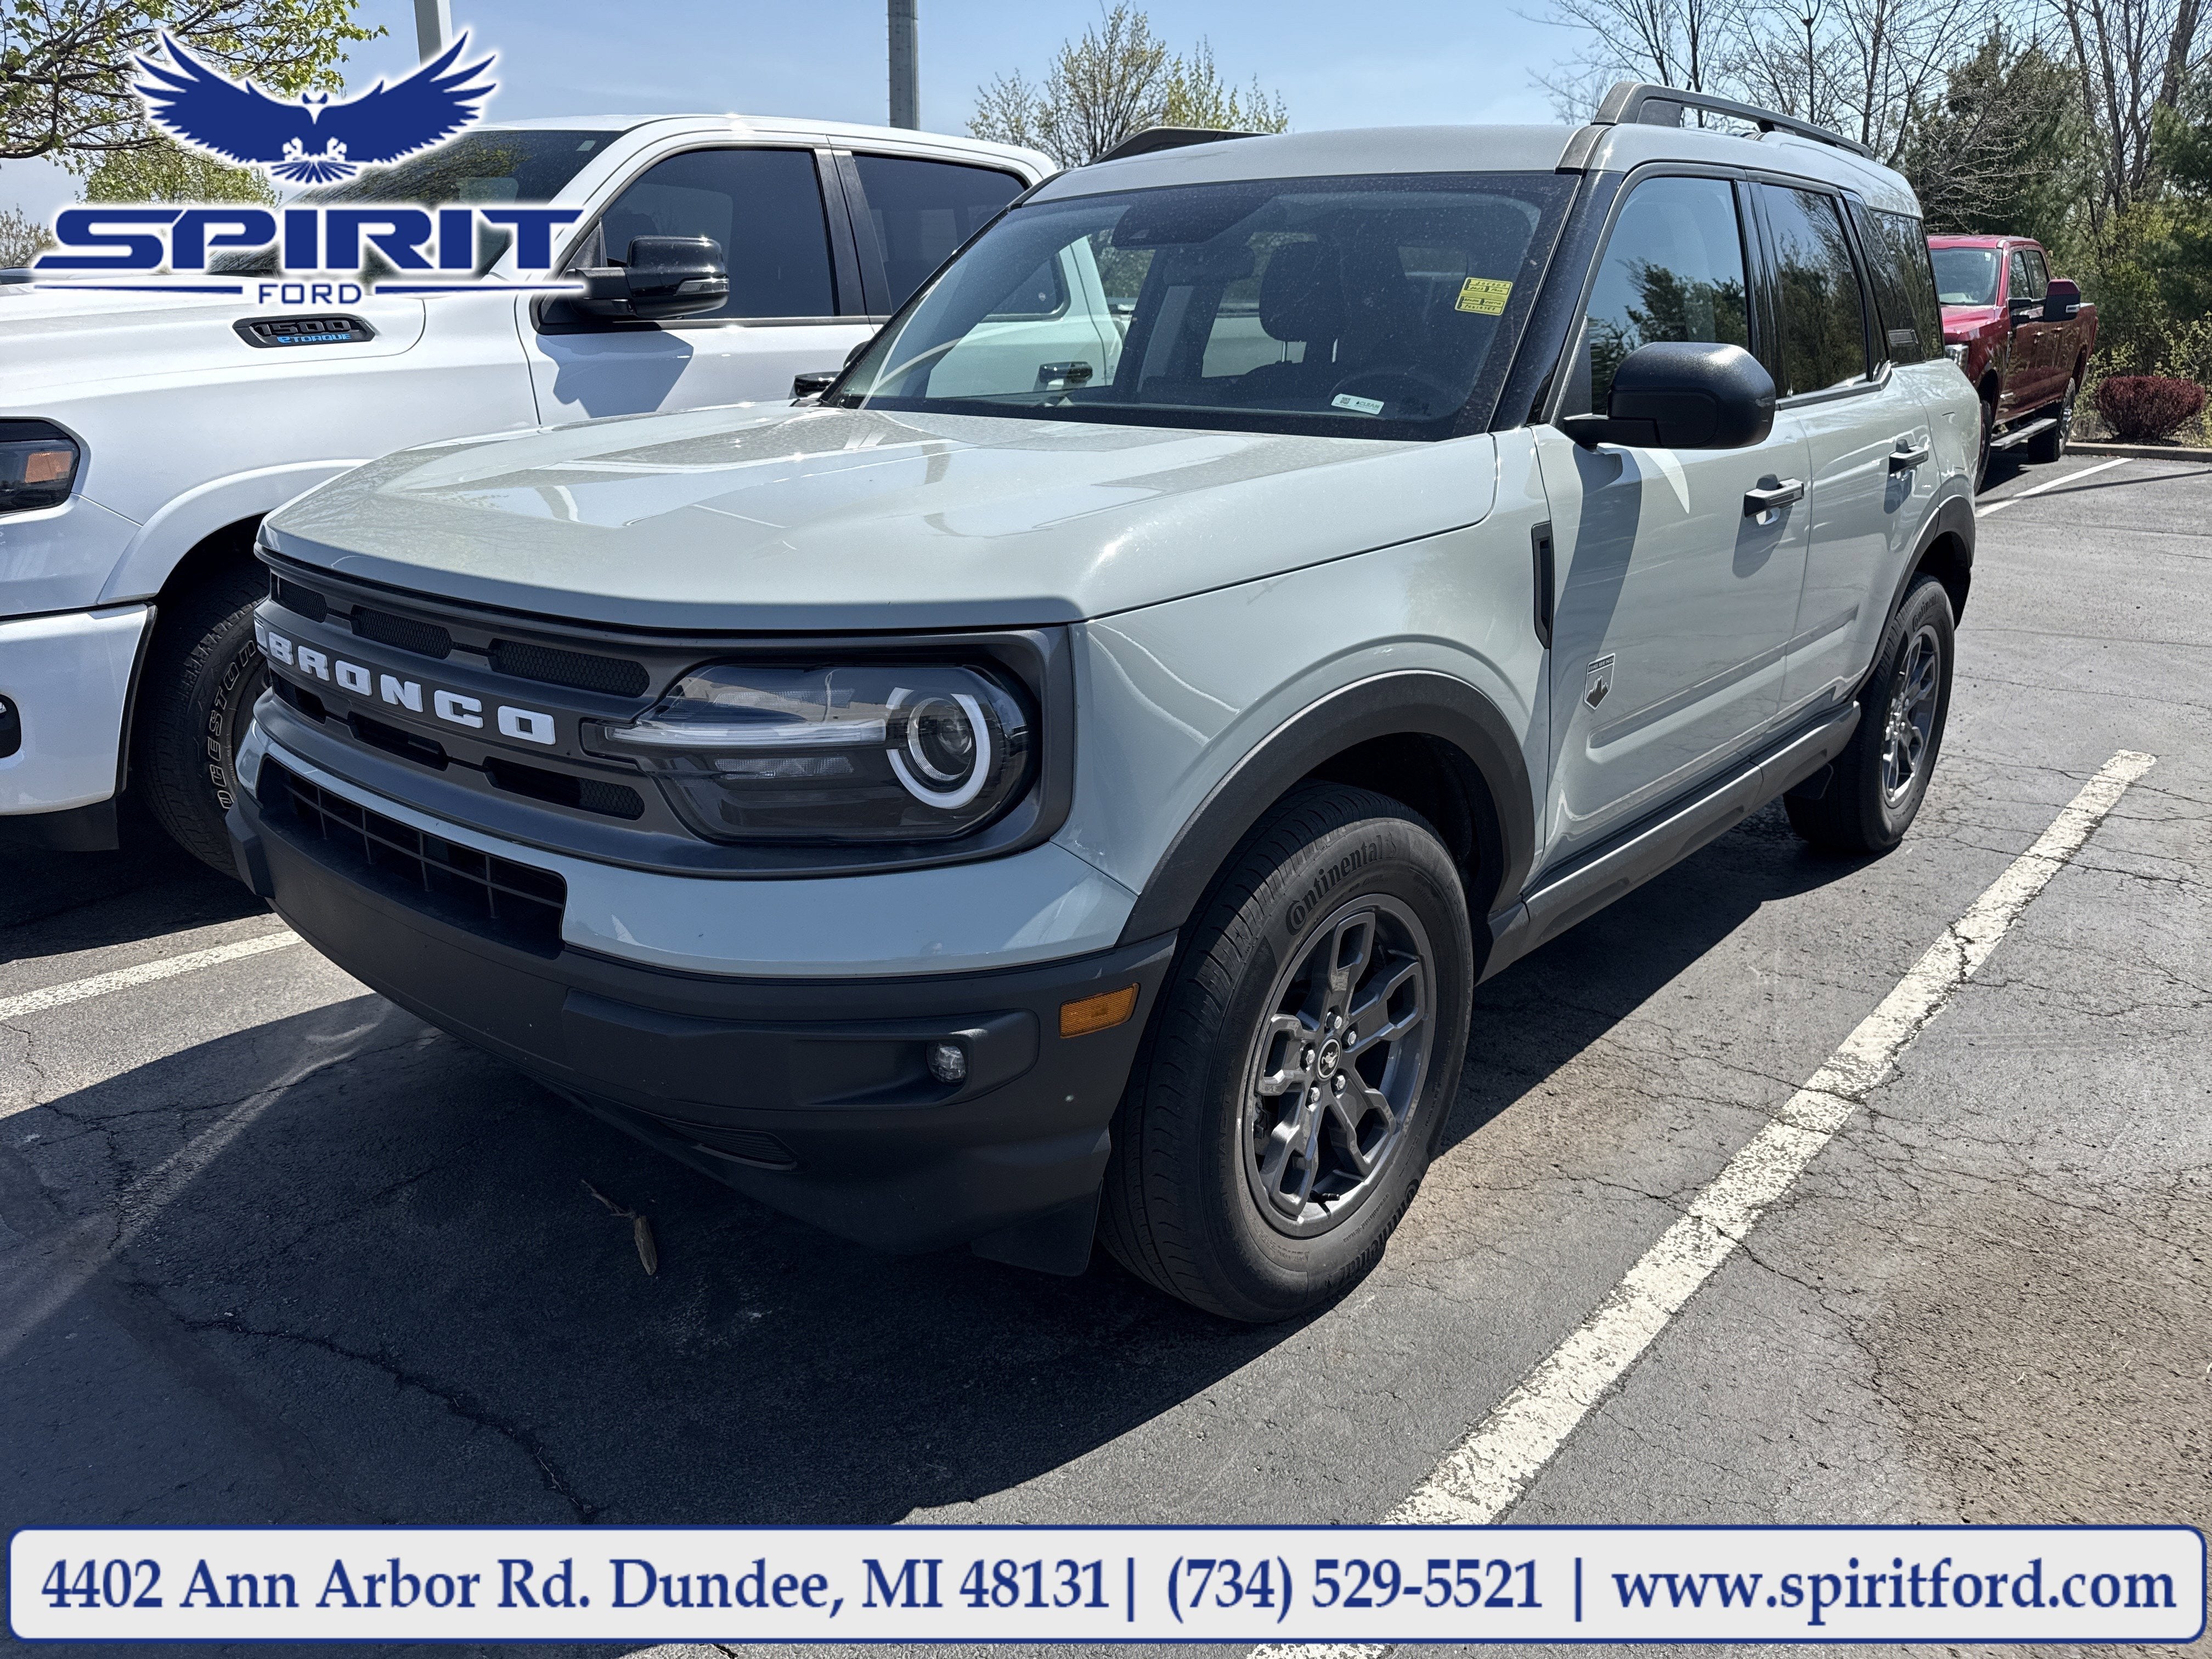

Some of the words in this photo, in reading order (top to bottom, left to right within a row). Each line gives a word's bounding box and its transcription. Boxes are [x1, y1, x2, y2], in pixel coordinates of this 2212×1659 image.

[255, 320, 351, 336] 1500
[268, 631, 556, 745] BRONCO
[1285, 834, 1383, 936] Continental
